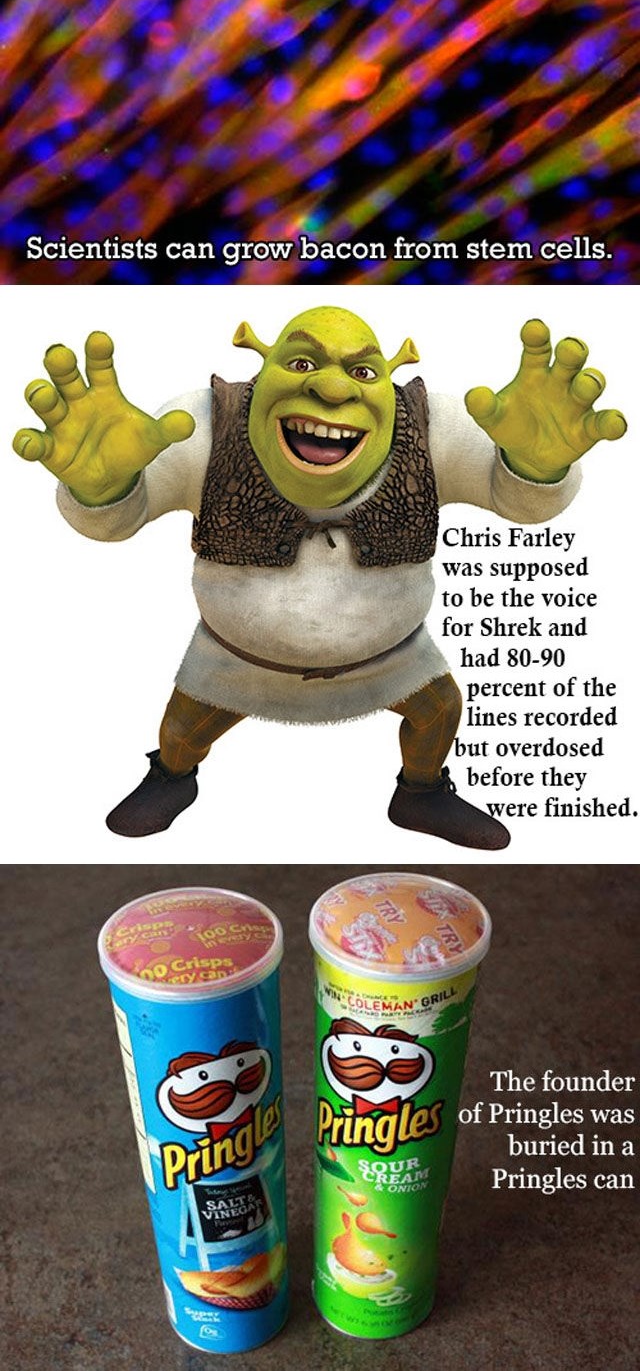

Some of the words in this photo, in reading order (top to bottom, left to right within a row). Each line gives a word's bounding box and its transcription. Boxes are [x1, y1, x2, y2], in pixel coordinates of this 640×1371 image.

[375, 899, 405, 924] TRY
[198, 927, 227, 942] 100
[436, 922, 464, 954] TRY
[171, 957, 234, 972] Crisps
[347, 996, 414, 1012] COLEMAN
[421, 987, 458, 1007] GRILL
[318, 1099, 444, 1155] Pringles
[160, 1096, 282, 1189] Pringles
[358, 1157, 420, 1173] SOUR
[362, 1165, 432, 1184] CREAM
[374, 1184, 383, 1192] &
[387, 1181, 429, 1193] ONION
[201, 1198, 263, 1220] VINEGAR
[205, 1195, 247, 1211] SALT
